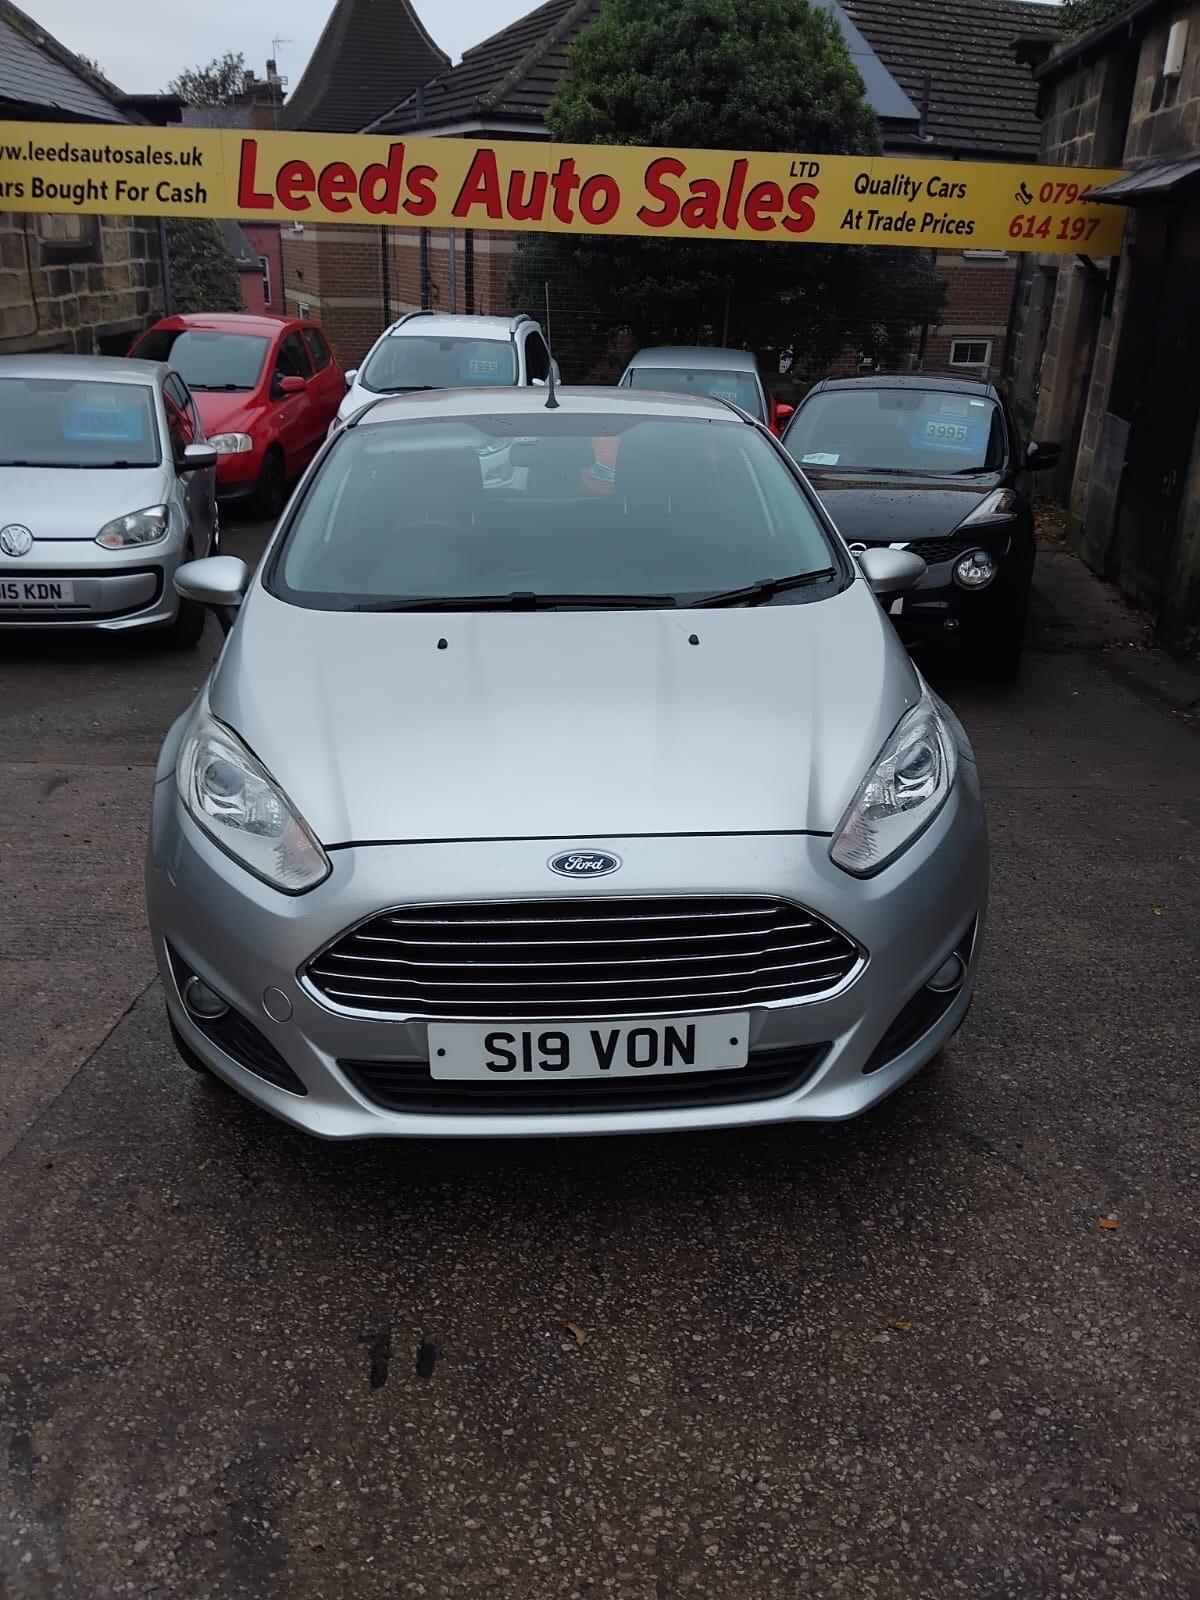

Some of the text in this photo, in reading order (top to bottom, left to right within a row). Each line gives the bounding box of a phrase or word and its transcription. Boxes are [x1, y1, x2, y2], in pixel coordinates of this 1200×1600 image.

[0, 140, 203, 167] w.leedsautosales.uk
[789, 160, 821, 179] LTD
[31, 176, 108, 206] Bought
[115, 179, 150, 202] For
[155, 181, 208, 204] Cash
[237, 138, 820, 233] Leeds Auto Sales
[854, 172, 968, 202] Quality Cars
[840, 208, 975, 236] At Trade Prices
[1008, 214, 1102, 242] 614 197
[927, 424, 966, 441] 3995
[0, 583, 63, 600] 15 KDN
[564, 855, 604, 870] Ford
[484, 1024, 696, 1073] S19 VON
